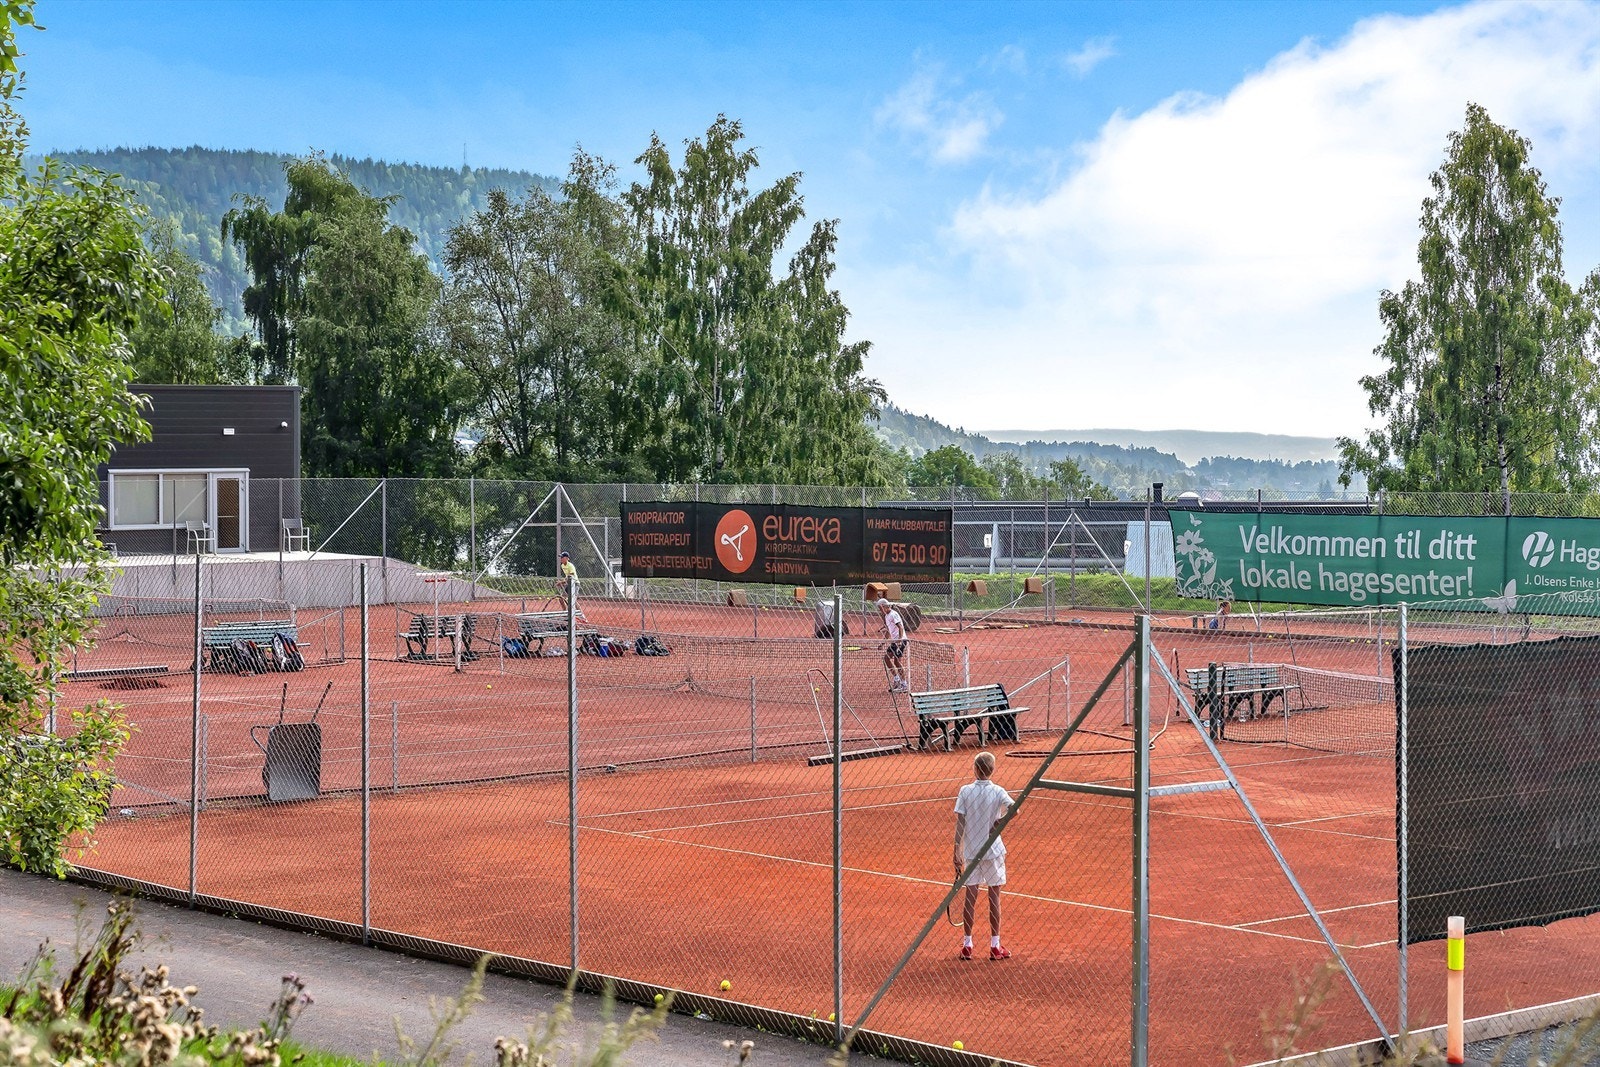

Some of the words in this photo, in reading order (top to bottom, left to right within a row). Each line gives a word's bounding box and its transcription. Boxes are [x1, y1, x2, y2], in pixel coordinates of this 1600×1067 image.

[628, 512, 685, 524] KIROPRAKTOR
[763, 515, 841, 544] eureka
[867, 519, 874, 529] VI
[875, 519, 890, 529] HAR
[891, 520, 946, 532] KLUBBAVTALE!
[629, 533, 691, 546] FYSIOTERAPEUT
[1239, 525, 1386, 558] Velkommen
[1394, 530, 1421, 559] til
[1428, 530, 1477, 560] ditt
[765, 543, 818, 555] KIROPRAKTIKK
[873, 543, 888, 562] 67
[891, 543, 906, 563] 55
[910, 544, 926, 565] 00
[930, 545, 946, 565] 90
[1560, 539, 1600, 571] Hag
[630, 556, 713, 570] MASSASJETERAPEUT
[765, 562, 809, 575] SANDVIKA
[1239, 559, 1312, 590] lokale
[1319, 562, 1474, 600] hagesenter!
[1525, 574, 1532, 585] J.
[1534, 574, 1567, 587] Olsens
[1569, 576, 1594, 588] Enke
